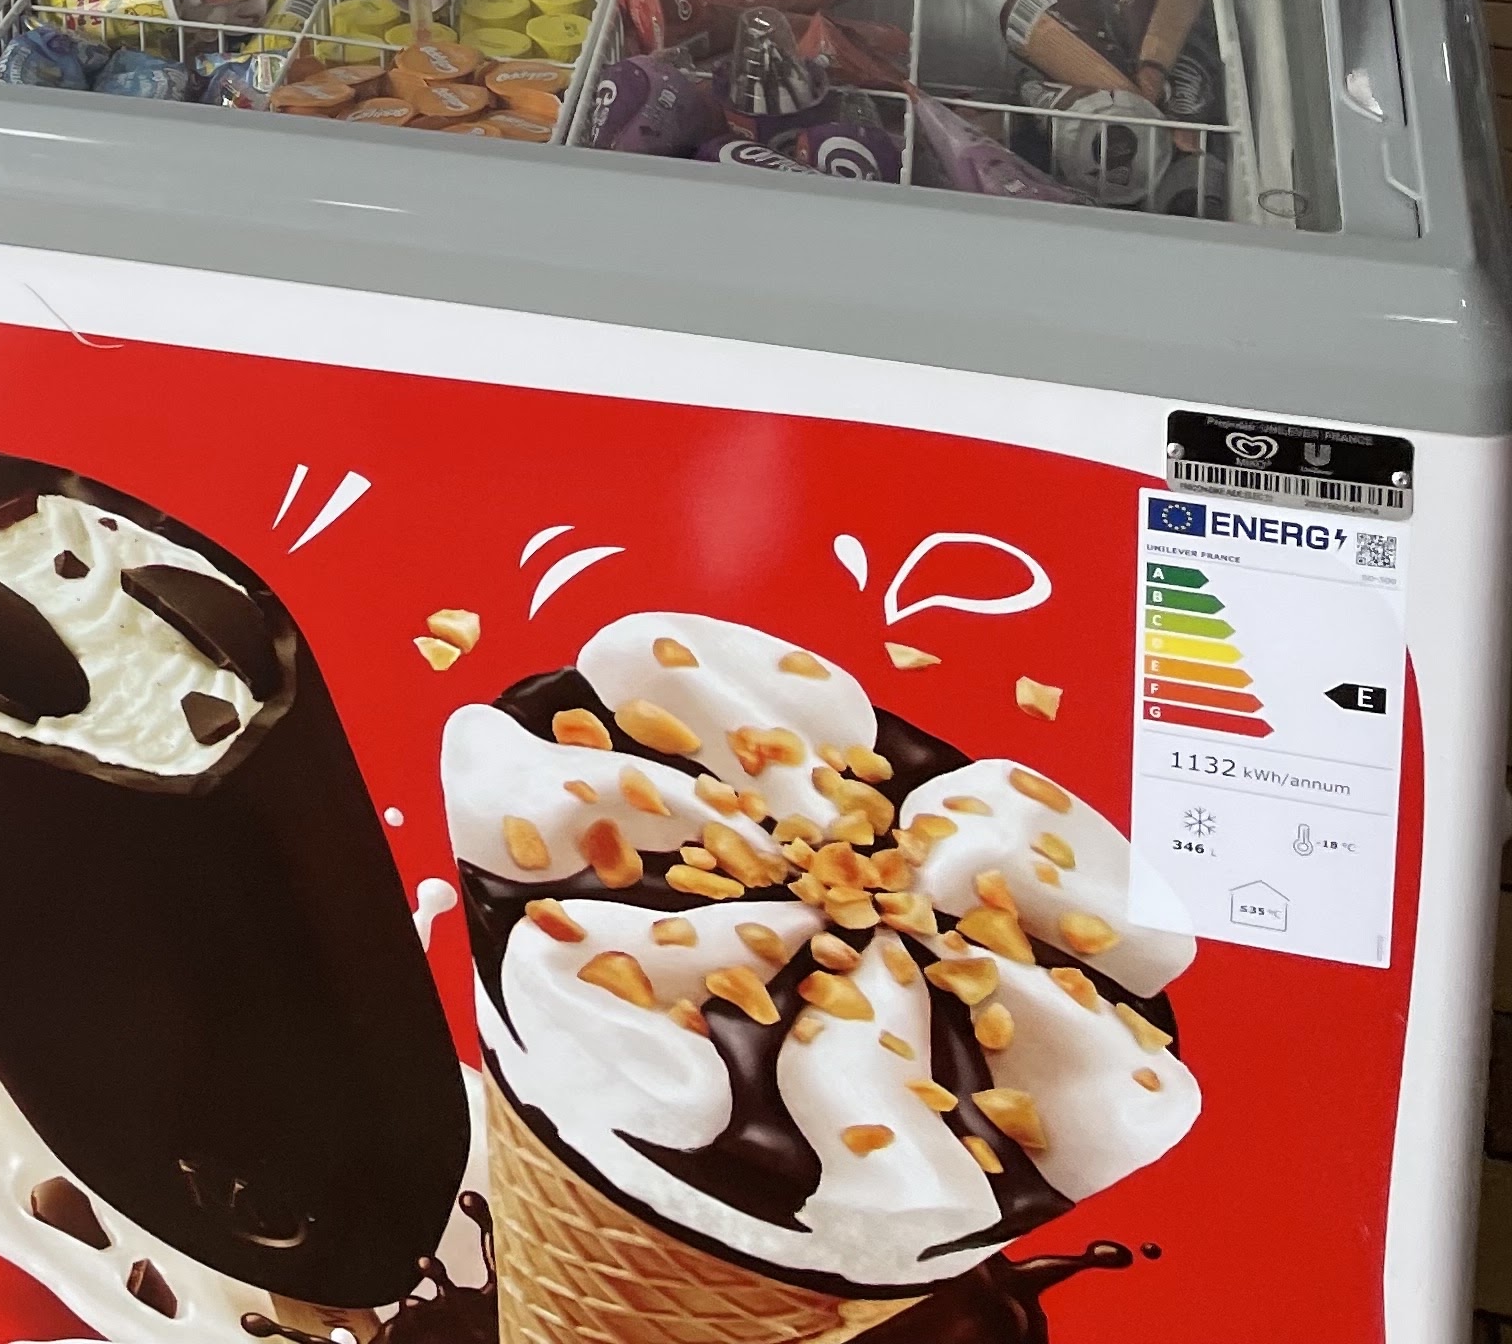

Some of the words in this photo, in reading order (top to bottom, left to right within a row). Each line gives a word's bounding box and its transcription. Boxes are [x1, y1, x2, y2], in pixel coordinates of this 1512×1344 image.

[1211, 511, 1330, 551] ENERG
[1146, 543, 1199, 558] UNILEVER
[1201, 551, 1241, 564] FRANCE
[1152, 567, 1165, 581] A
[1152, 591, 1163, 603] B
[1152, 614, 1162, 626] C
[1151, 660, 1159, 672] E
[1150, 683, 1159, 694] F
[1357, 687, 1375, 710] E
[1149, 706, 1161, 719] G
[1170, 751, 1237, 778] 1132
[1243, 766, 1351, 795] kWh/annum
[1172, 839, 1205, 855] 346
